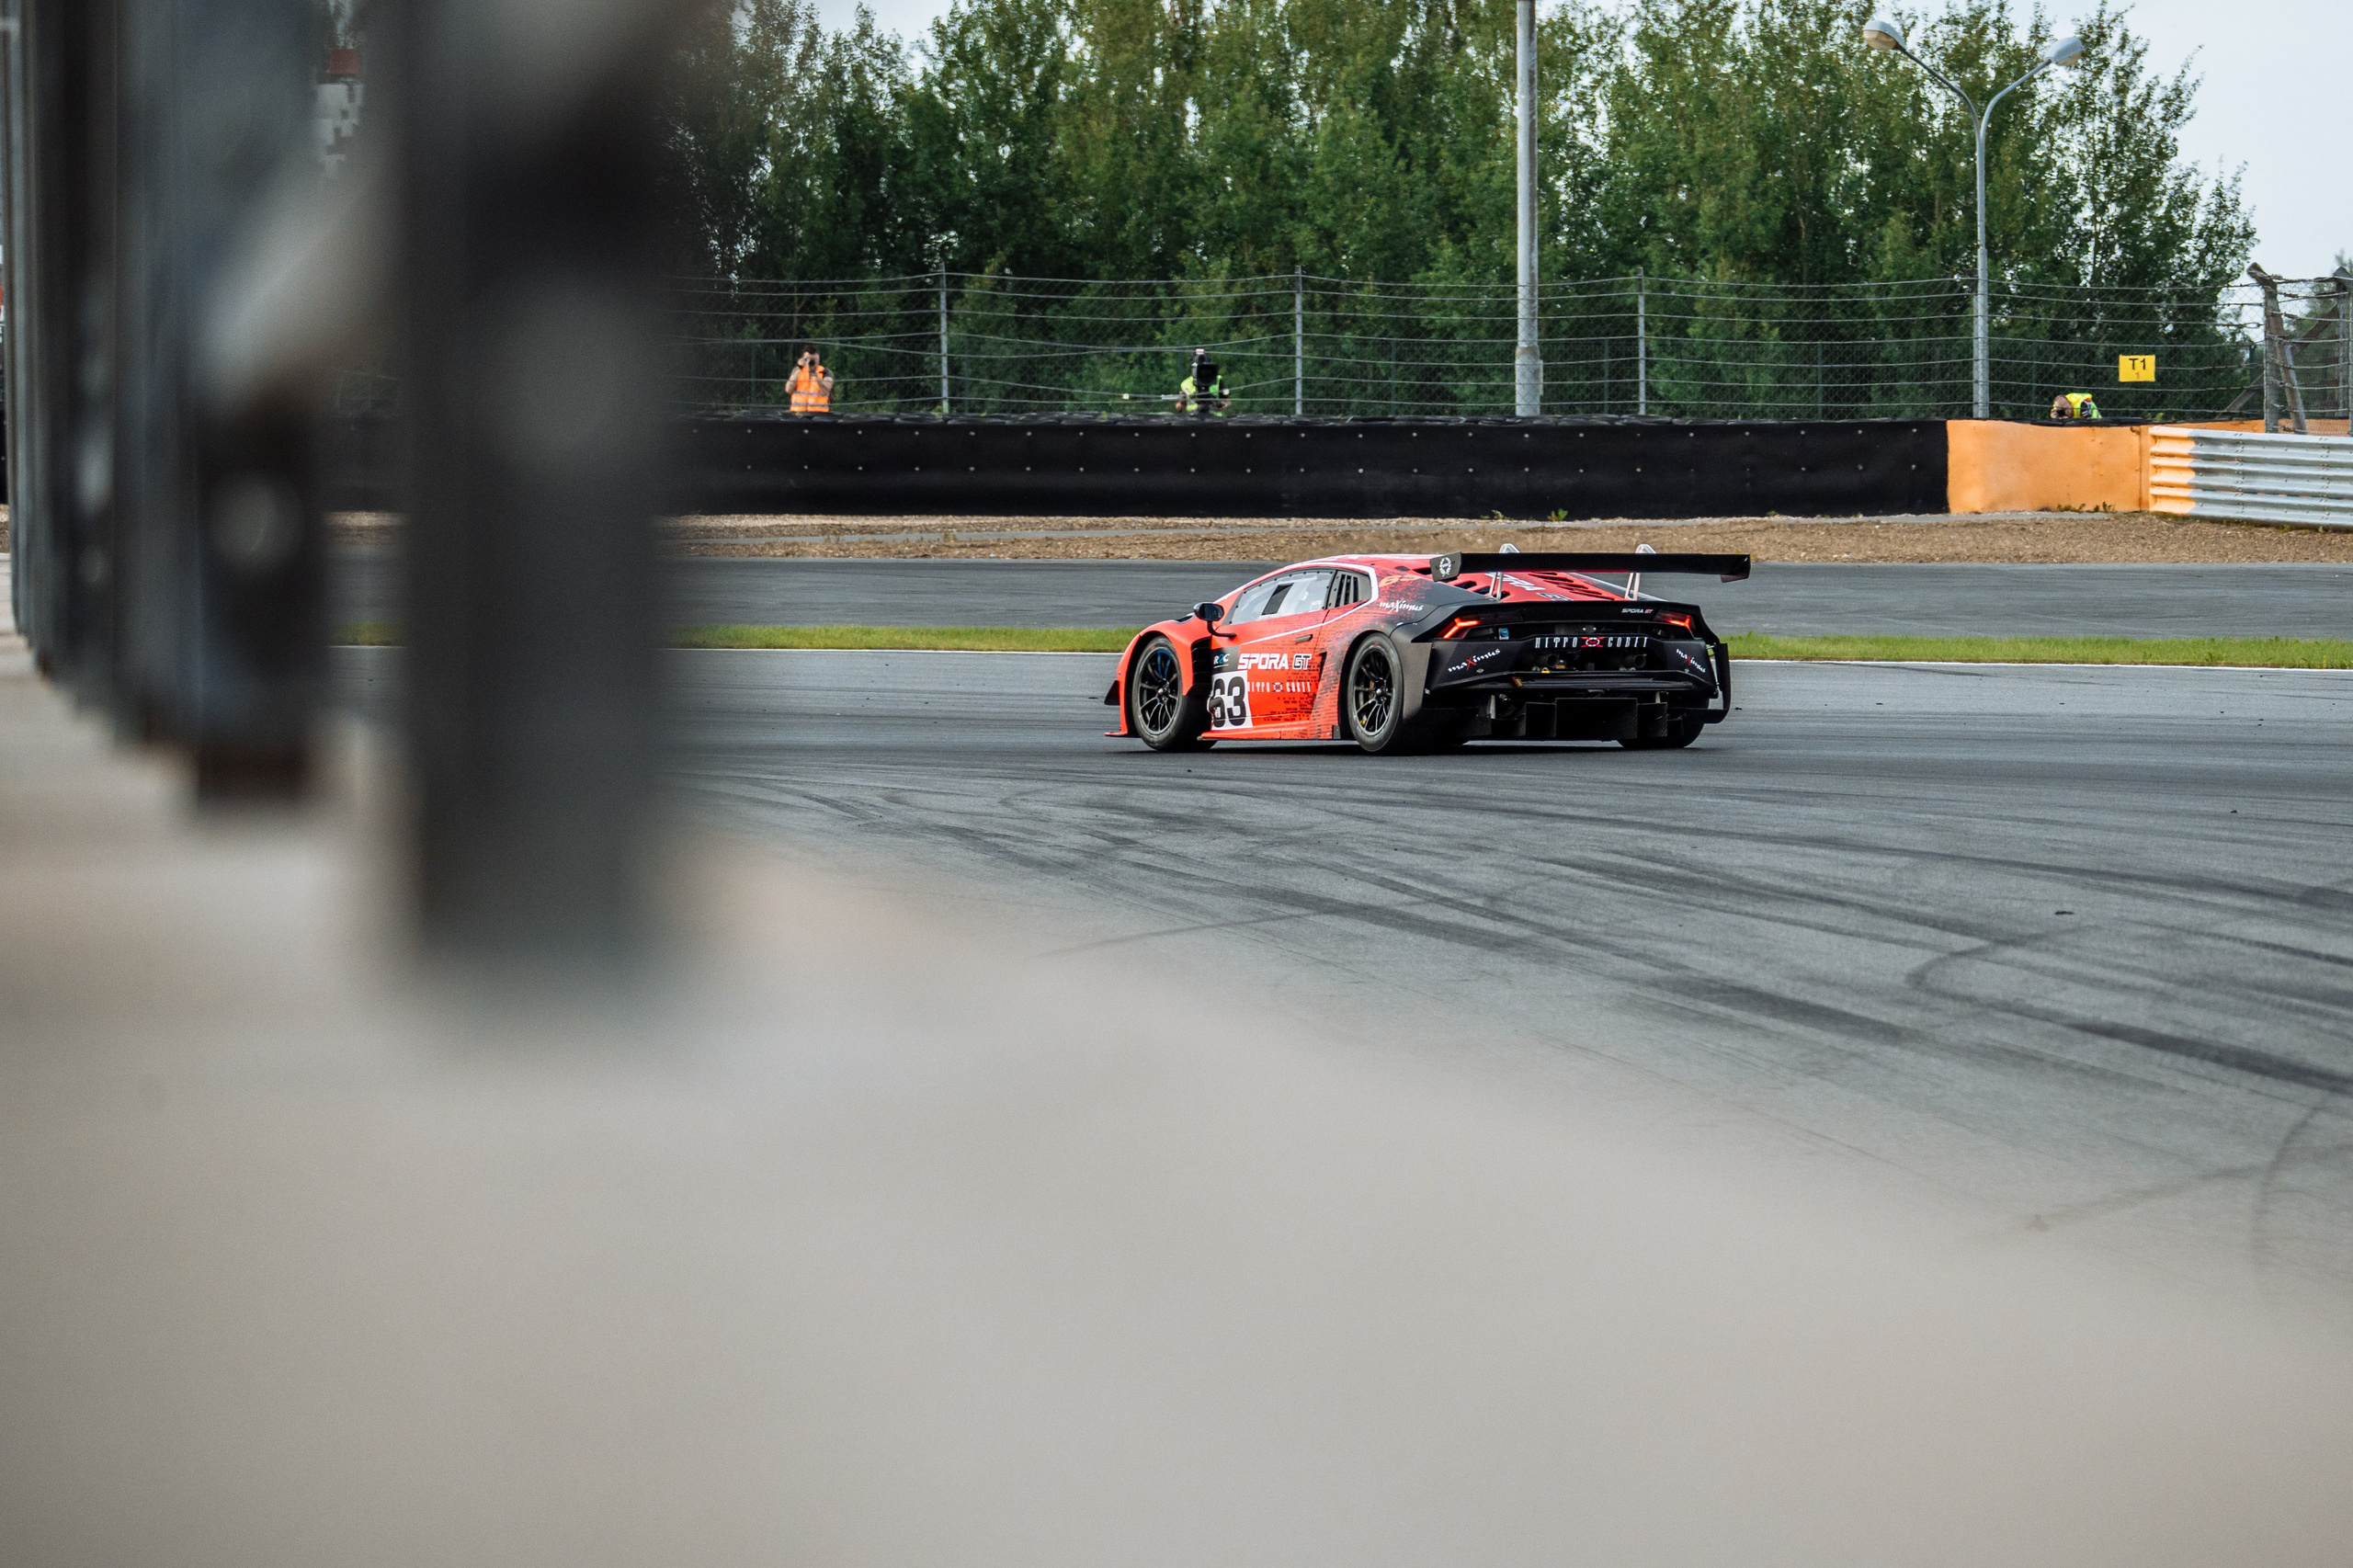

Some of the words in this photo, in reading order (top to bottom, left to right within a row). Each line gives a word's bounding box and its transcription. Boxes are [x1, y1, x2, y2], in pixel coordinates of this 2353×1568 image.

[2128, 358, 2146, 370] T1
[1237, 653, 1289, 670] SPORA
[1292, 653, 1313, 670] GT
[1212, 676, 1246, 728] 63
